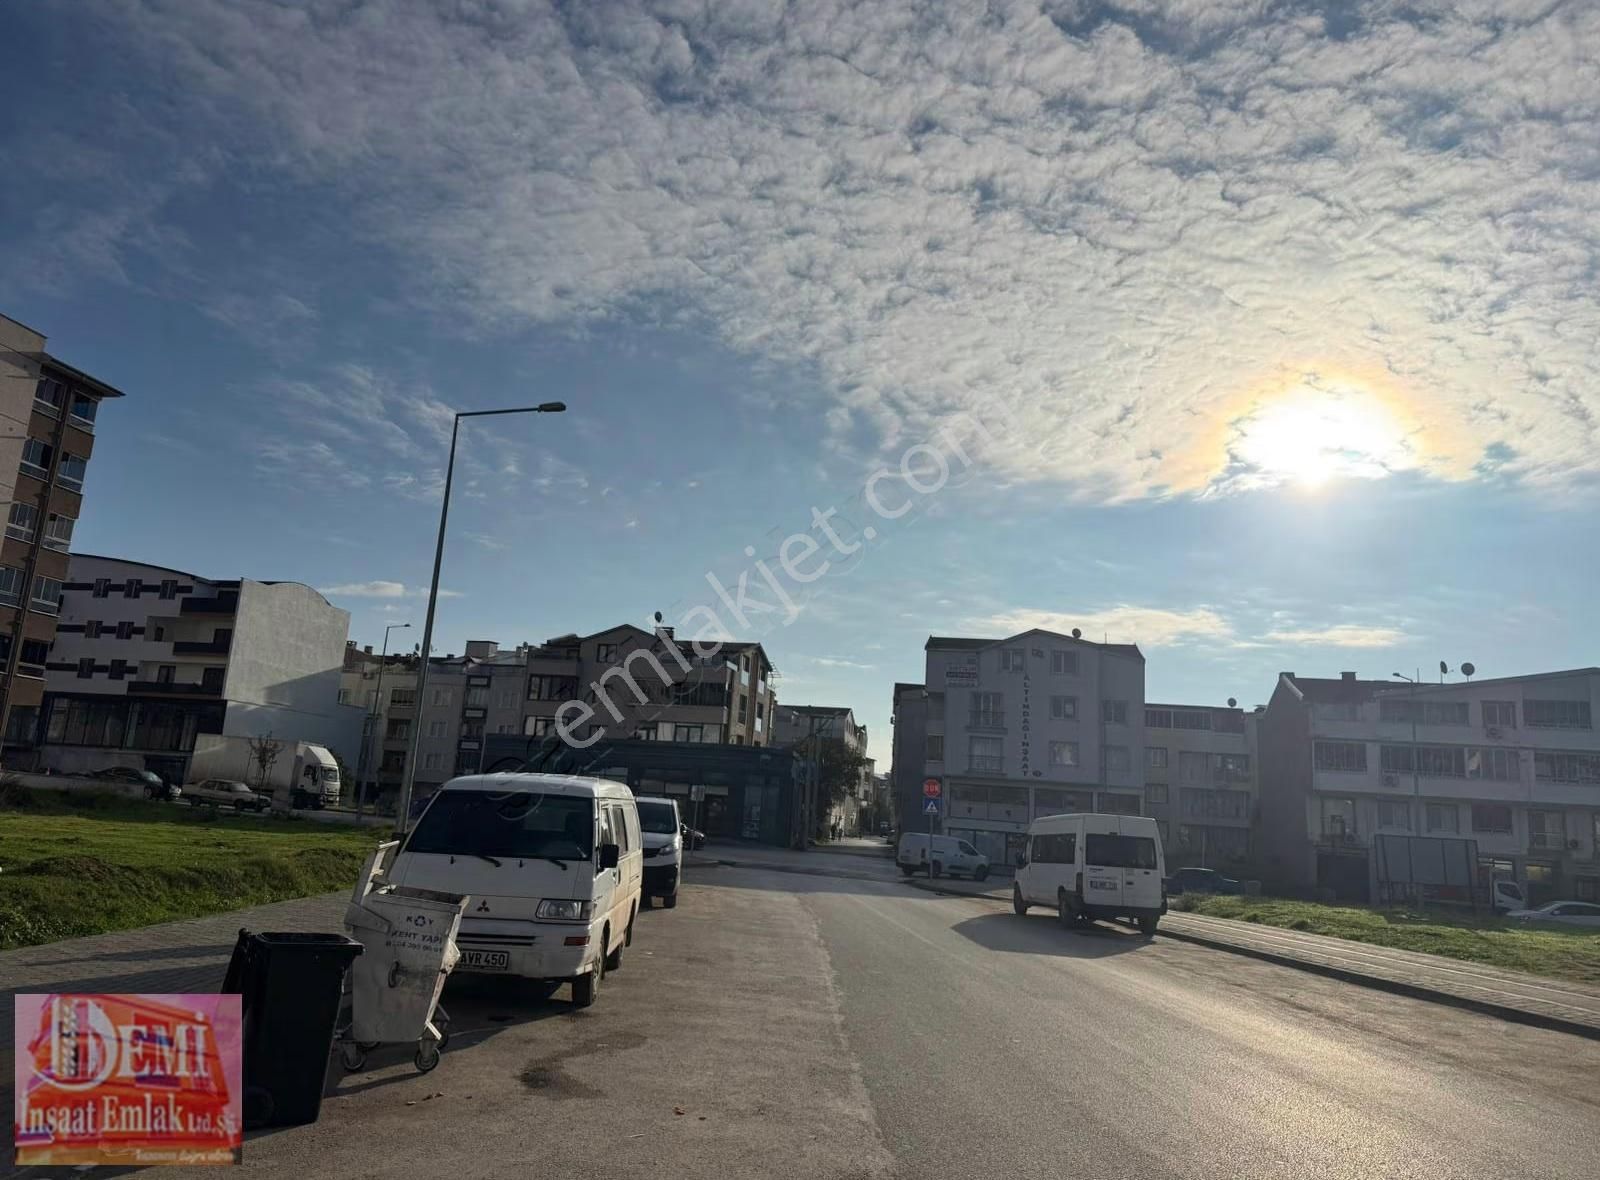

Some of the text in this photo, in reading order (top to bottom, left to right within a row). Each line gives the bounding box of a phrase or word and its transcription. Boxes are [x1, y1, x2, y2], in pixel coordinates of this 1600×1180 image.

[924, 784, 939, 792] DUR
[391, 931, 419, 941] KENT
[460, 952, 506, 966] AVR 450
